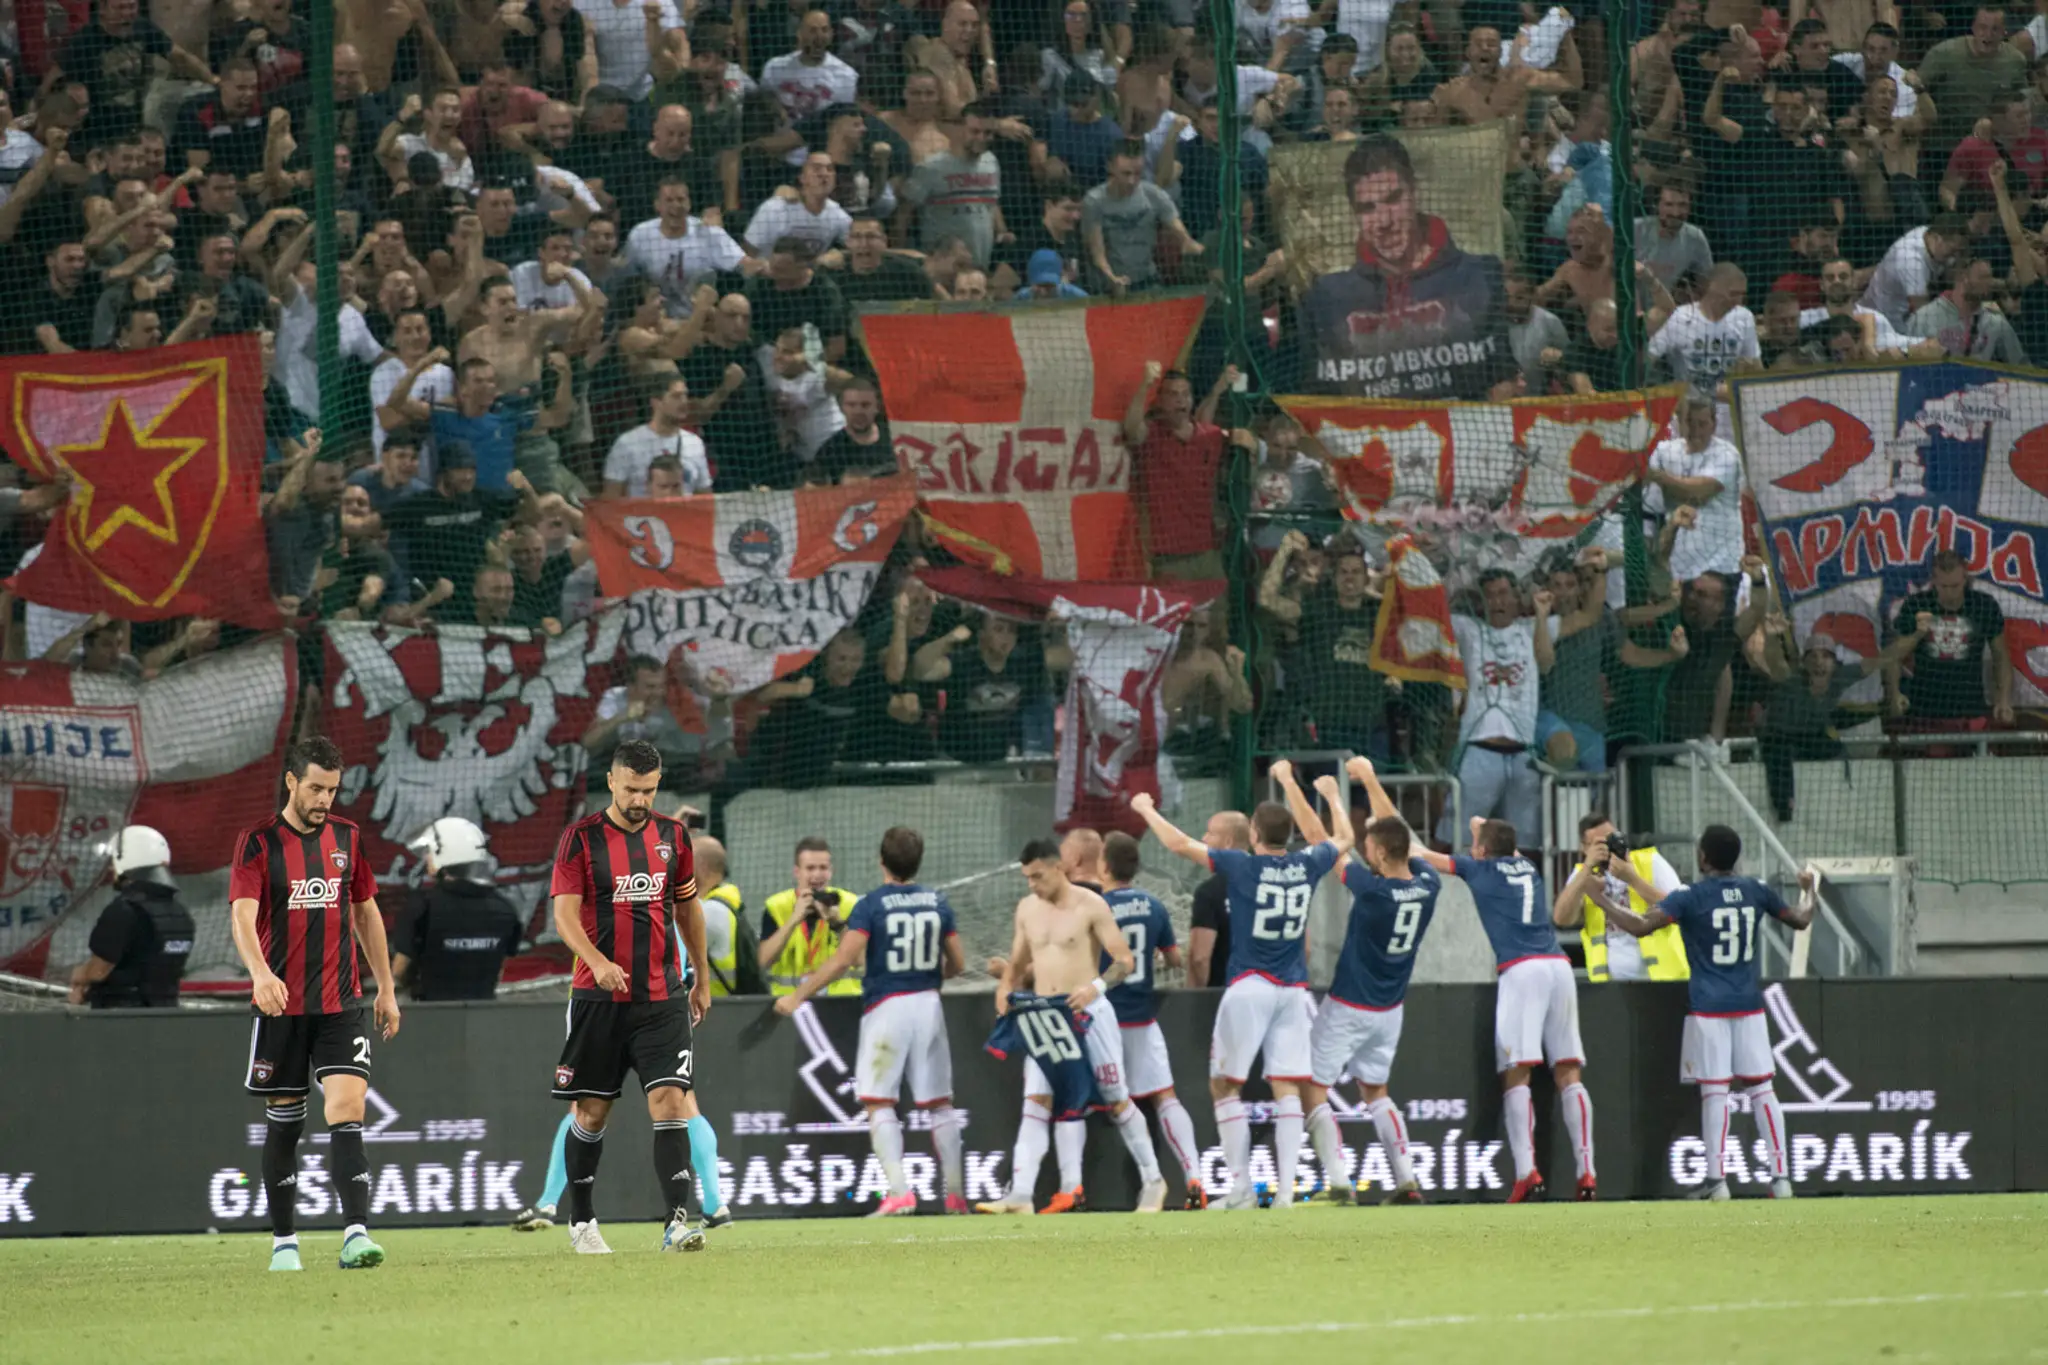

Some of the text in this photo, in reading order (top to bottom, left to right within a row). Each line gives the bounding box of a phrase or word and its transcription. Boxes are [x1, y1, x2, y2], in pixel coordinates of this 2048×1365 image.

[287, 877, 342, 903] ZOS
[612, 872, 667, 897] ZOS
[1506, 874, 1534, 924] 7
[1252, 882, 1312, 940] 29
[1386, 902, 1422, 955] 9
[1712, 906, 1755, 965] 31
[443, 936, 502, 950] SECURITY
[886, 911, 942, 972] 30
[1017, 1008, 1083, 1064] 49
[731, 1108, 969, 1135] EST. 195
[1407, 1098, 1468, 1120] 1995
[1875, 1090, 1936, 1111] 1995
[422, 1118, 488, 1142] 1995
[209, 1150, 525, 1219] GŠARÍK
[696, 1144, 1005, 1206] GAŠPARK
